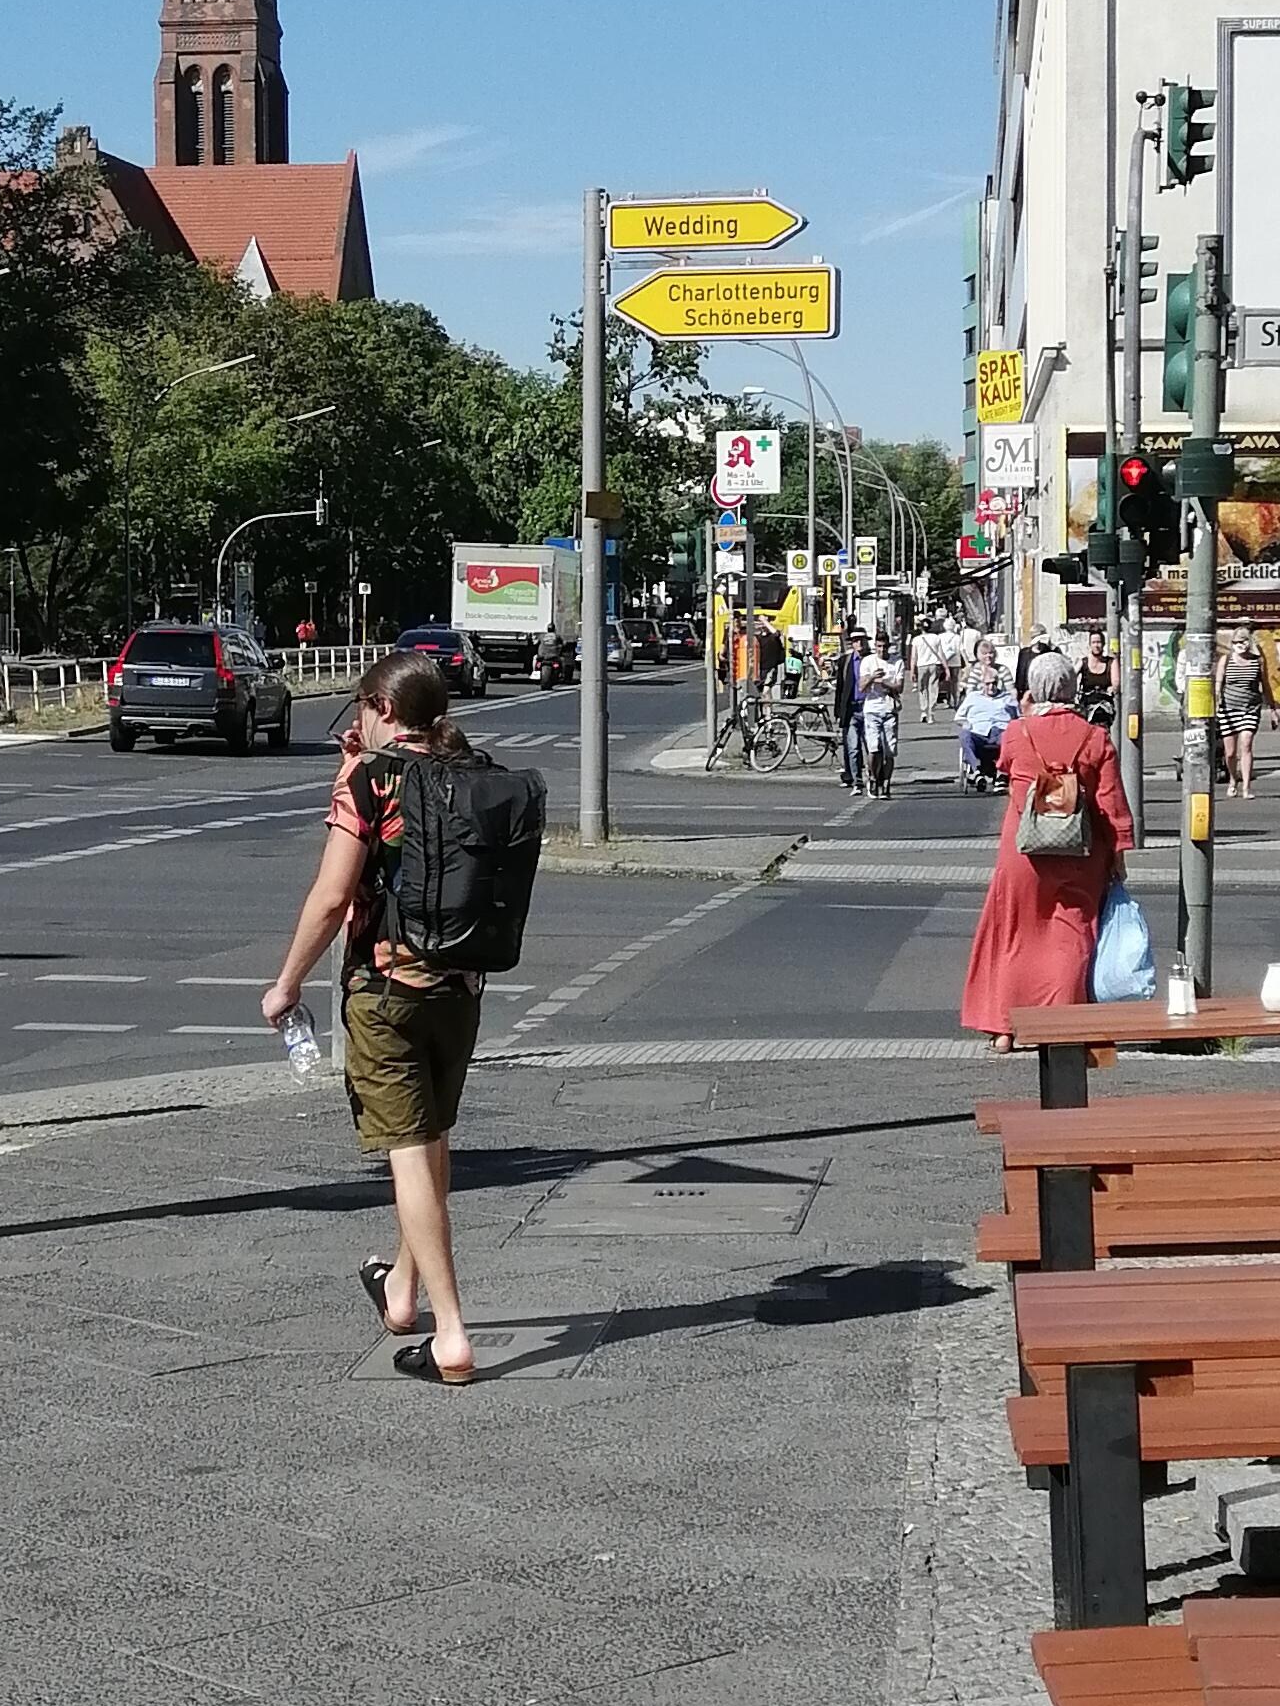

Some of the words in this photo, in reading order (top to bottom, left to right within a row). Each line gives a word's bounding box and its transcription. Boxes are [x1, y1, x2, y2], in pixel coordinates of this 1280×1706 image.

[644, 214, 739, 238] Wedding
[668, 283, 820, 303] Charlottenburg
[684, 308, 804, 328] Schöneberg
[979, 353, 1019, 385] SPÄT
[980, 376, 1021, 408] KAUF
